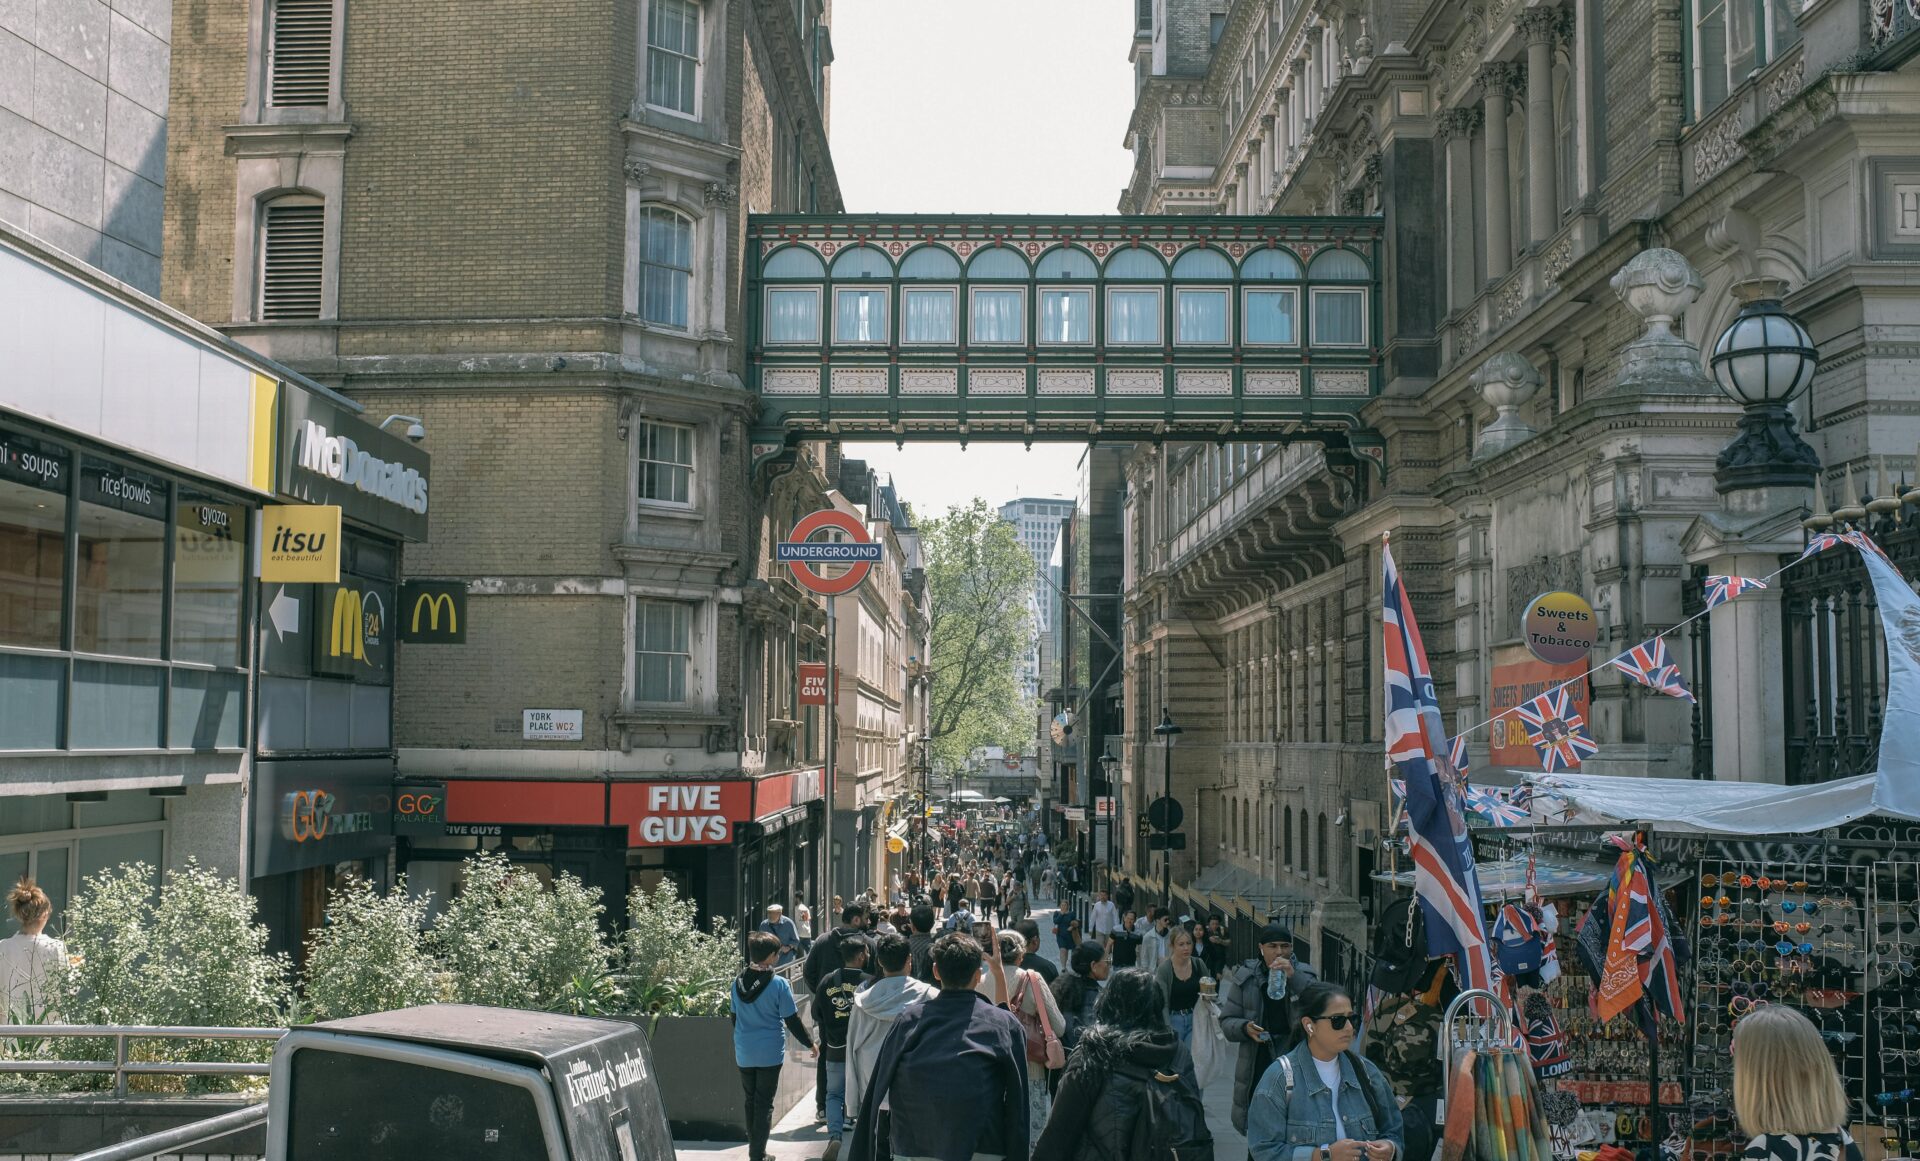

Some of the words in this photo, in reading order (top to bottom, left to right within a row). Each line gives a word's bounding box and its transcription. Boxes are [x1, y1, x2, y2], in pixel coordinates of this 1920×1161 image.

[22, 452, 59, 481] soups
[299, 419, 428, 514] McDonald's
[202, 505, 227, 526] gyoza
[272, 525, 326, 553] itsu
[286, 553, 323, 562] beautiful
[781, 546, 878, 558] UNDERGROUND
[1536, 606, 1589, 622] Sweets
[368, 613, 380, 636] 24
[1556, 622, 1567, 633] &
[1531, 632, 1591, 649] Tobacco
[805, 676, 826, 686] FIV
[1493, 684, 1518, 708] SWEETS
[529, 722, 554, 731] PLACE
[555, 722, 575, 731] WC2
[530, 712, 552, 721] YORK
[1508, 719, 1531, 746] CIGA
[398, 794, 436, 815] GO
[649, 785, 720, 811] FIVE
[393, 814, 441, 824] FALAFEL
[640, 815, 728, 843] GUYS
[470, 825, 502, 836] GUYS
[568, 1057, 588, 1076] London
[565, 1064, 610, 1107] Evening
[606, 1047, 648, 1092] Sandard
